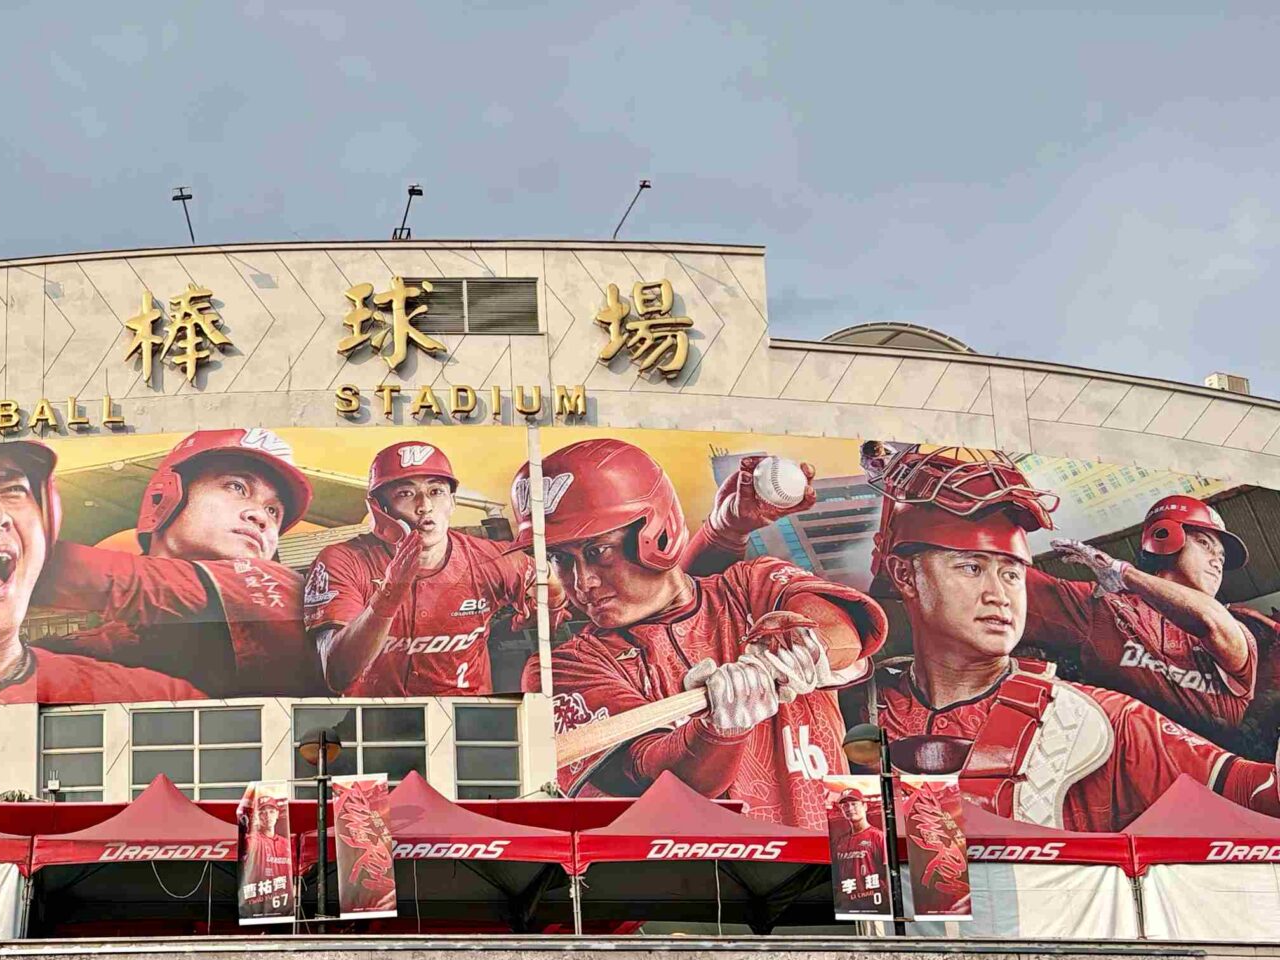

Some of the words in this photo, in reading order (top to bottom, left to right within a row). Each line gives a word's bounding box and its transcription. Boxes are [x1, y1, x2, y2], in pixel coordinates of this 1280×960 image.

[335, 383, 589, 421] STADIUM
[398, 445, 435, 468] W
[456, 662, 470, 689] 2
[782, 723, 829, 780] 46
[99, 840, 238, 861] DRAGONS
[646, 839, 788, 859] DRAGONS
[841, 873, 880, 895] 李超
[272, 893, 288, 909] 67
[873, 892, 882, 905] 0
